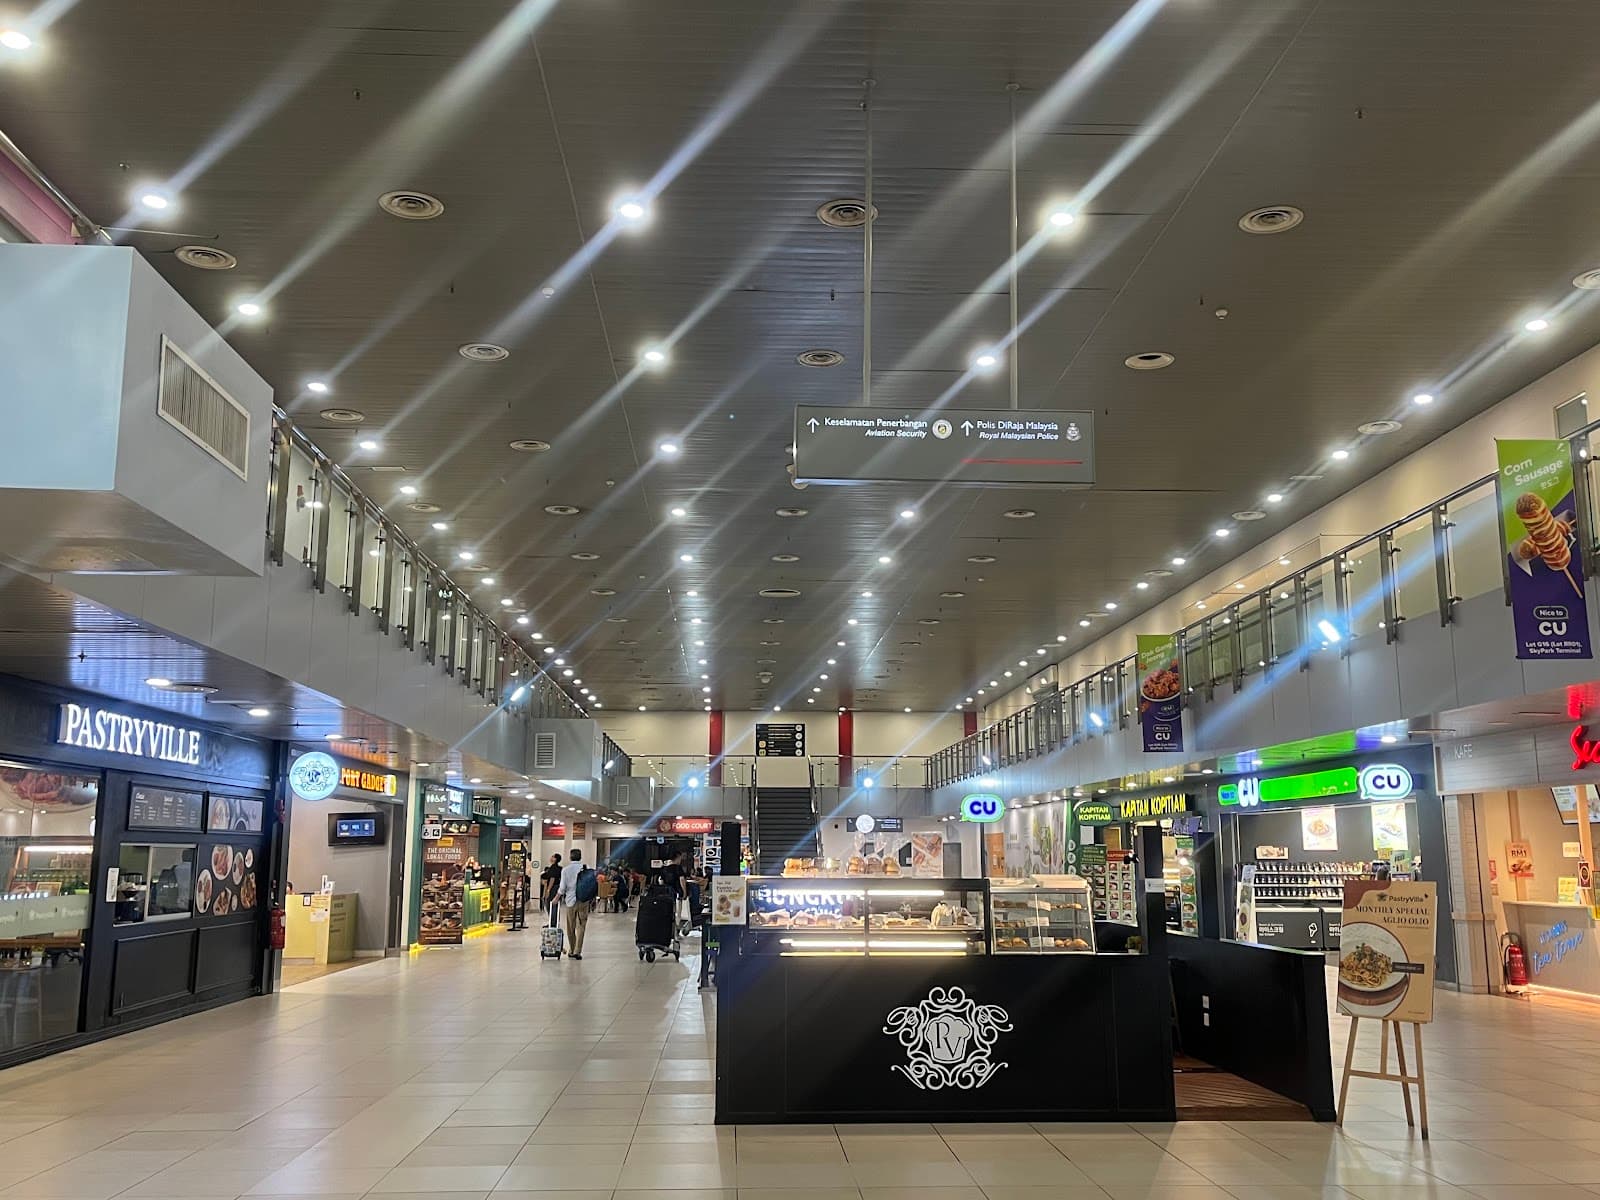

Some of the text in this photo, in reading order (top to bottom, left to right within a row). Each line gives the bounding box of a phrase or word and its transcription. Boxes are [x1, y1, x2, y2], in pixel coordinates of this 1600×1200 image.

[824, 417, 928, 429] Keselamatan Penerbangan
[976, 420, 1058, 432] Polis DiRaja Malaysia
[865, 428, 928, 439] Aviation Security
[979, 431, 1059, 442] Royal Malaysian Police
[1514, 460, 1564, 486] Sausage
[1539, 609, 1555, 617] Nice
[1538, 621, 1567, 636] CU
[62, 702, 201, 765] PASTRYVILLE
[1154, 732, 1171, 741] CU
[1454, 743, 1473, 760] KAFE
[1372, 774, 1401, 790] CU
[1237, 777, 1259, 807] CU
[969, 800, 997, 816] CU
[1079, 806, 1109, 814] KAPITAN
[1120, 793, 1186, 818] KAPITAN KOPITIAM
[1078, 813, 1111, 821] KOPITIAM
[1355, 905, 1430, 915] MONTHLY SPECIAL
[1383, 916, 1430, 926] AGLIO OLIO
